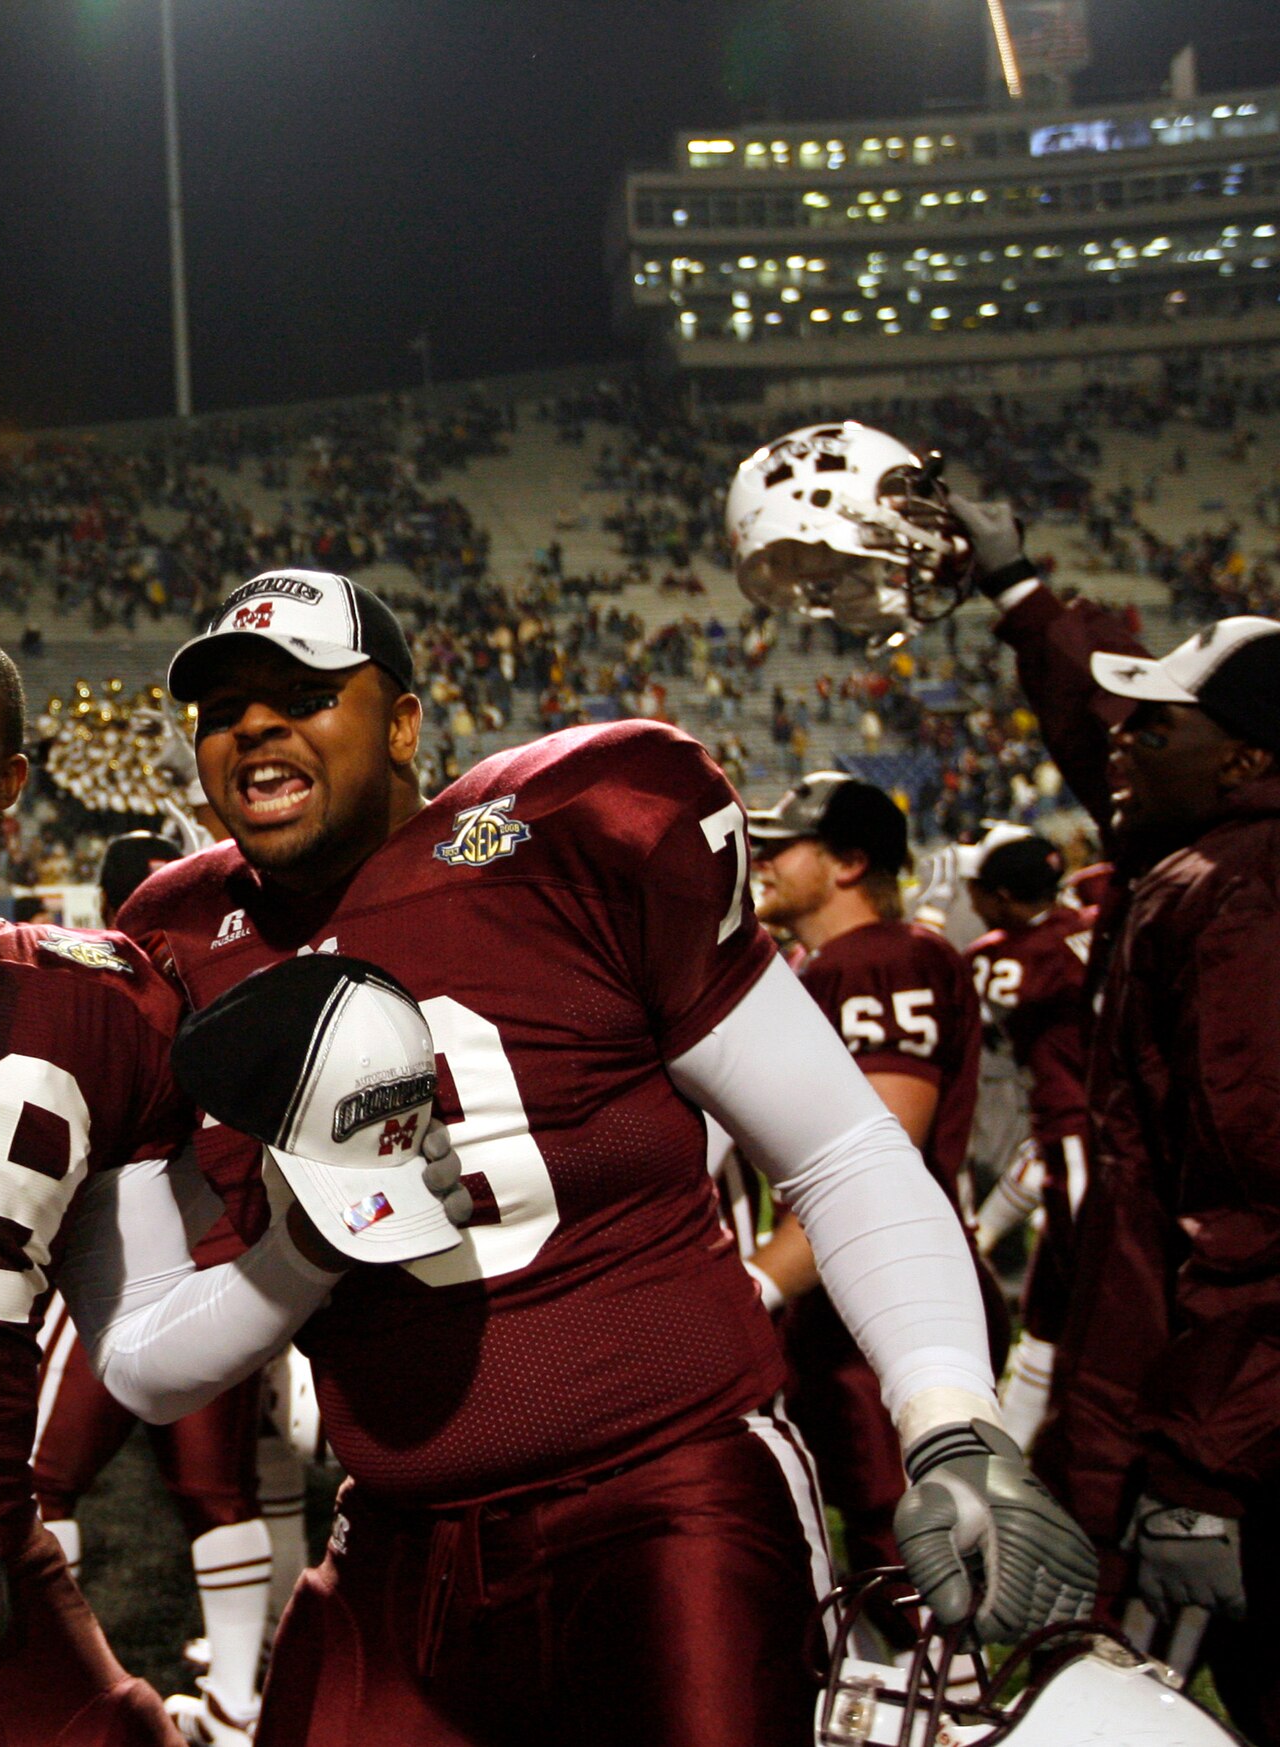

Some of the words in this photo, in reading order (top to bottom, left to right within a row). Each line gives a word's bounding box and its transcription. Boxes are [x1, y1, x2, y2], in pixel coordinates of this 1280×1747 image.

[462, 822, 500, 863] SEC
[210, 928, 251, 950] RUSSELL
[841, 988, 938, 1058] 65
